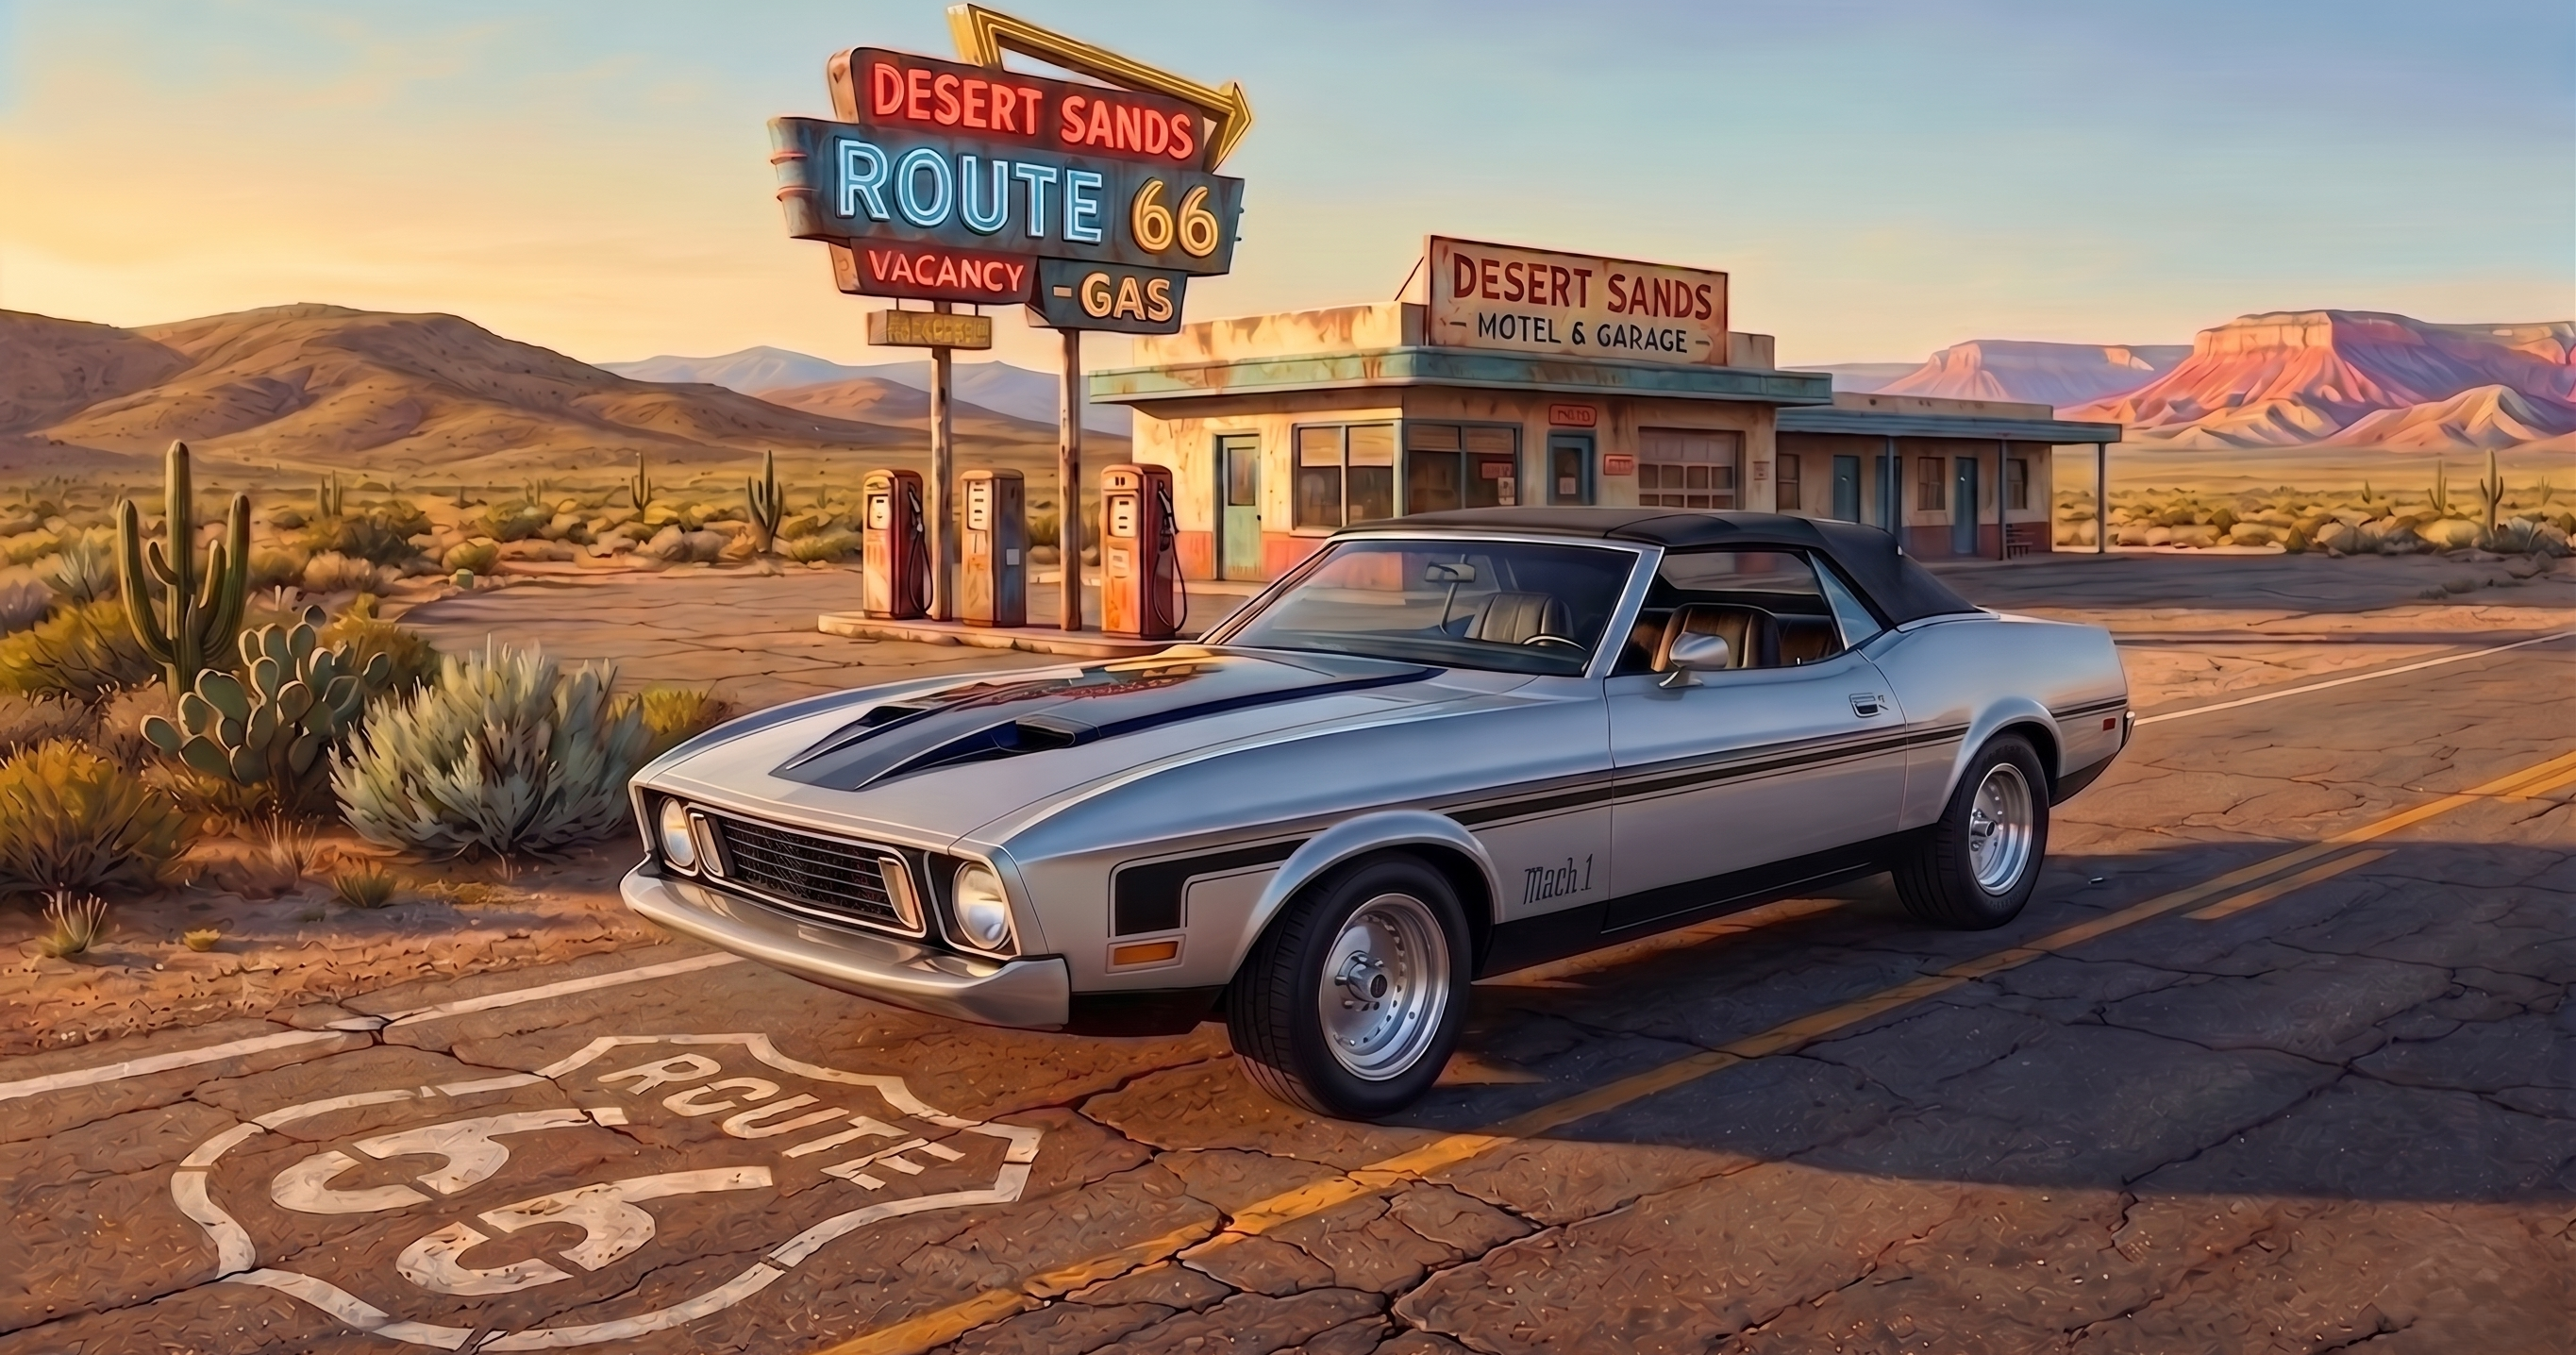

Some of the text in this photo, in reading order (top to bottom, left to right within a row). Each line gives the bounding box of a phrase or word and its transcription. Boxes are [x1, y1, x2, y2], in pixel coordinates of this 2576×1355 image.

[872, 62, 1195, 159] DESERT SANDS
[835, 137, 1219, 257] ROUTE 66
[868, 249, 1025, 293] VACANCY
[1452, 252, 1713, 321] DESERT SANDS
[1477, 311, 1689, 354] MOTEL & GARAGE
[596, 1053, 967, 1192] ROUTE
